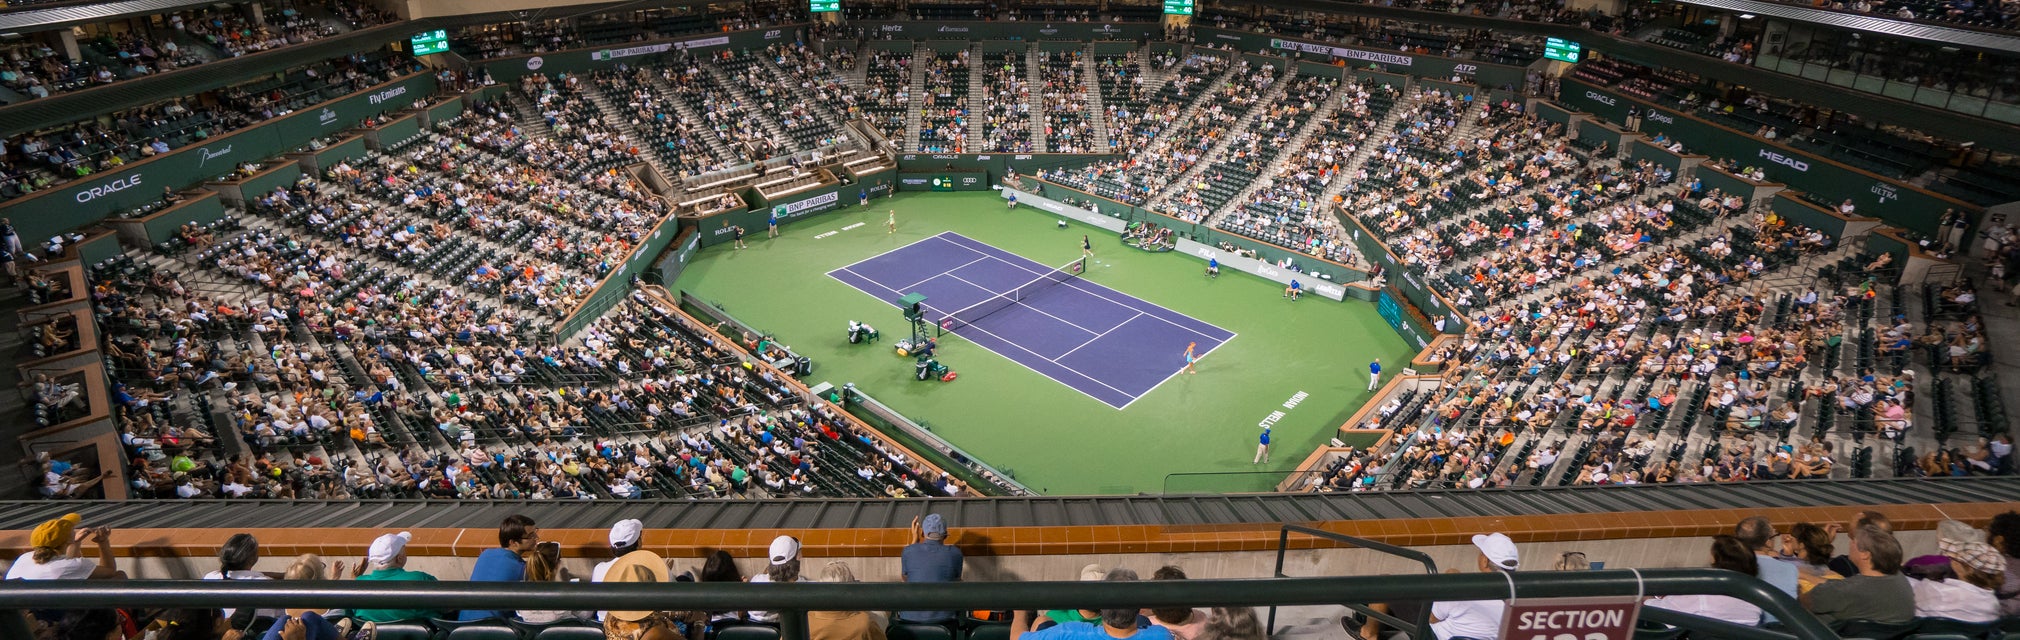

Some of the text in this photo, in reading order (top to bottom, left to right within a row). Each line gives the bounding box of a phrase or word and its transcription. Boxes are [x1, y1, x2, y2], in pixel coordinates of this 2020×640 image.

[437, 41, 448, 50] 40
[611, 49, 626, 57] BNP
[628, 46, 655, 55] PARIBAS
[1311, 45, 1335, 54] WES
[1346, 50, 1409, 65] BNP PARIBAS
[1567, 52, 1578, 60] 40
[1454, 63, 1477, 71] ATP
[369, 86, 406, 104] Fly Emirates
[1586, 91, 1616, 107] ORACLE
[1759, 149, 1809, 172] HEAD
[76, 174, 142, 203] ORACLE
[870, 184, 888, 193] ROLEX
[1871, 185, 1898, 200] ULTRA
[789, 192, 836, 212] BNP PARIBAS
[1258, 410, 1286, 430] WELLS
[1517, 609, 1624, 630] SECTION
